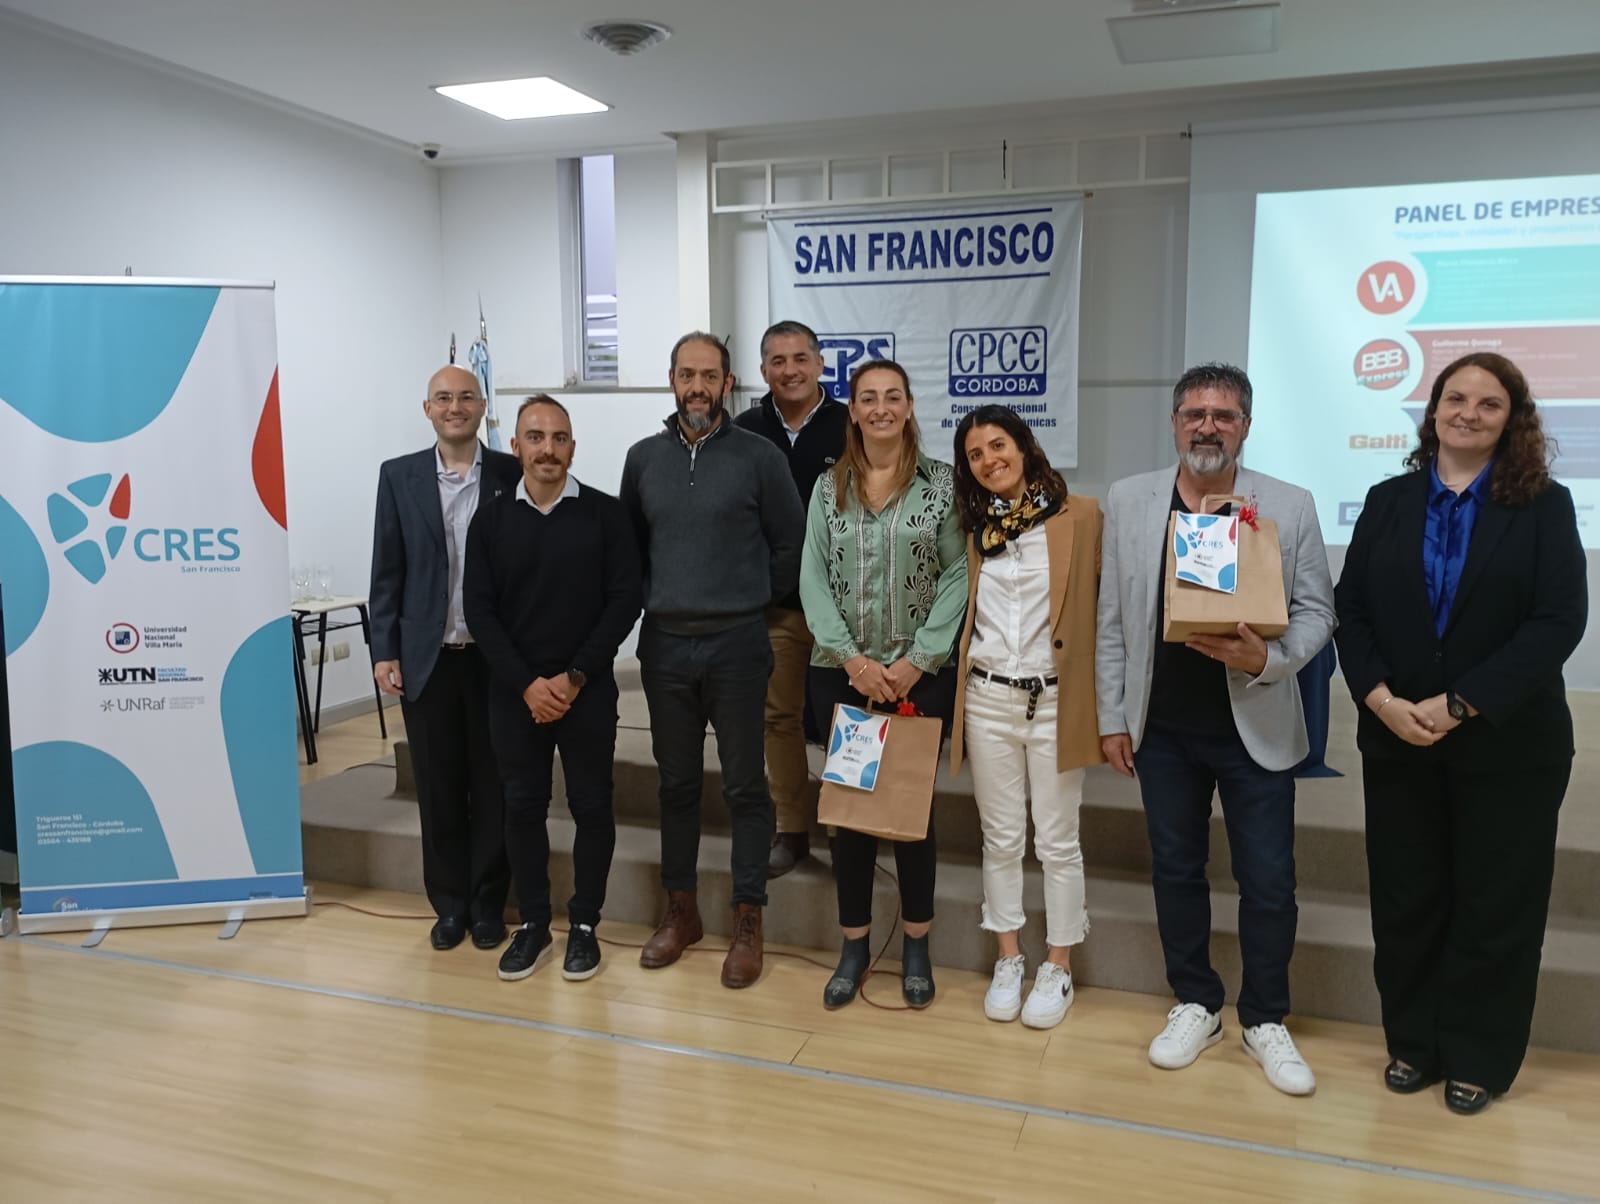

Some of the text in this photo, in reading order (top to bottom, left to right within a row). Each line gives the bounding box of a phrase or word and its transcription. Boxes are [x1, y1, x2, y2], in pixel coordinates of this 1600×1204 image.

[1394, 203, 1467, 224] PANEL
[1473, 201, 1504, 220] DE
[794, 221, 1054, 275] SAN FRANCISCO
[956, 331, 1040, 373] CPCE
[955, 378, 1039, 393] CORDOBA
[133, 528, 241, 562] CRES
[181, 565, 241, 573] San Francisco
[112, 667, 156, 682] UTN
[117, 697, 166, 712] UNRaf
